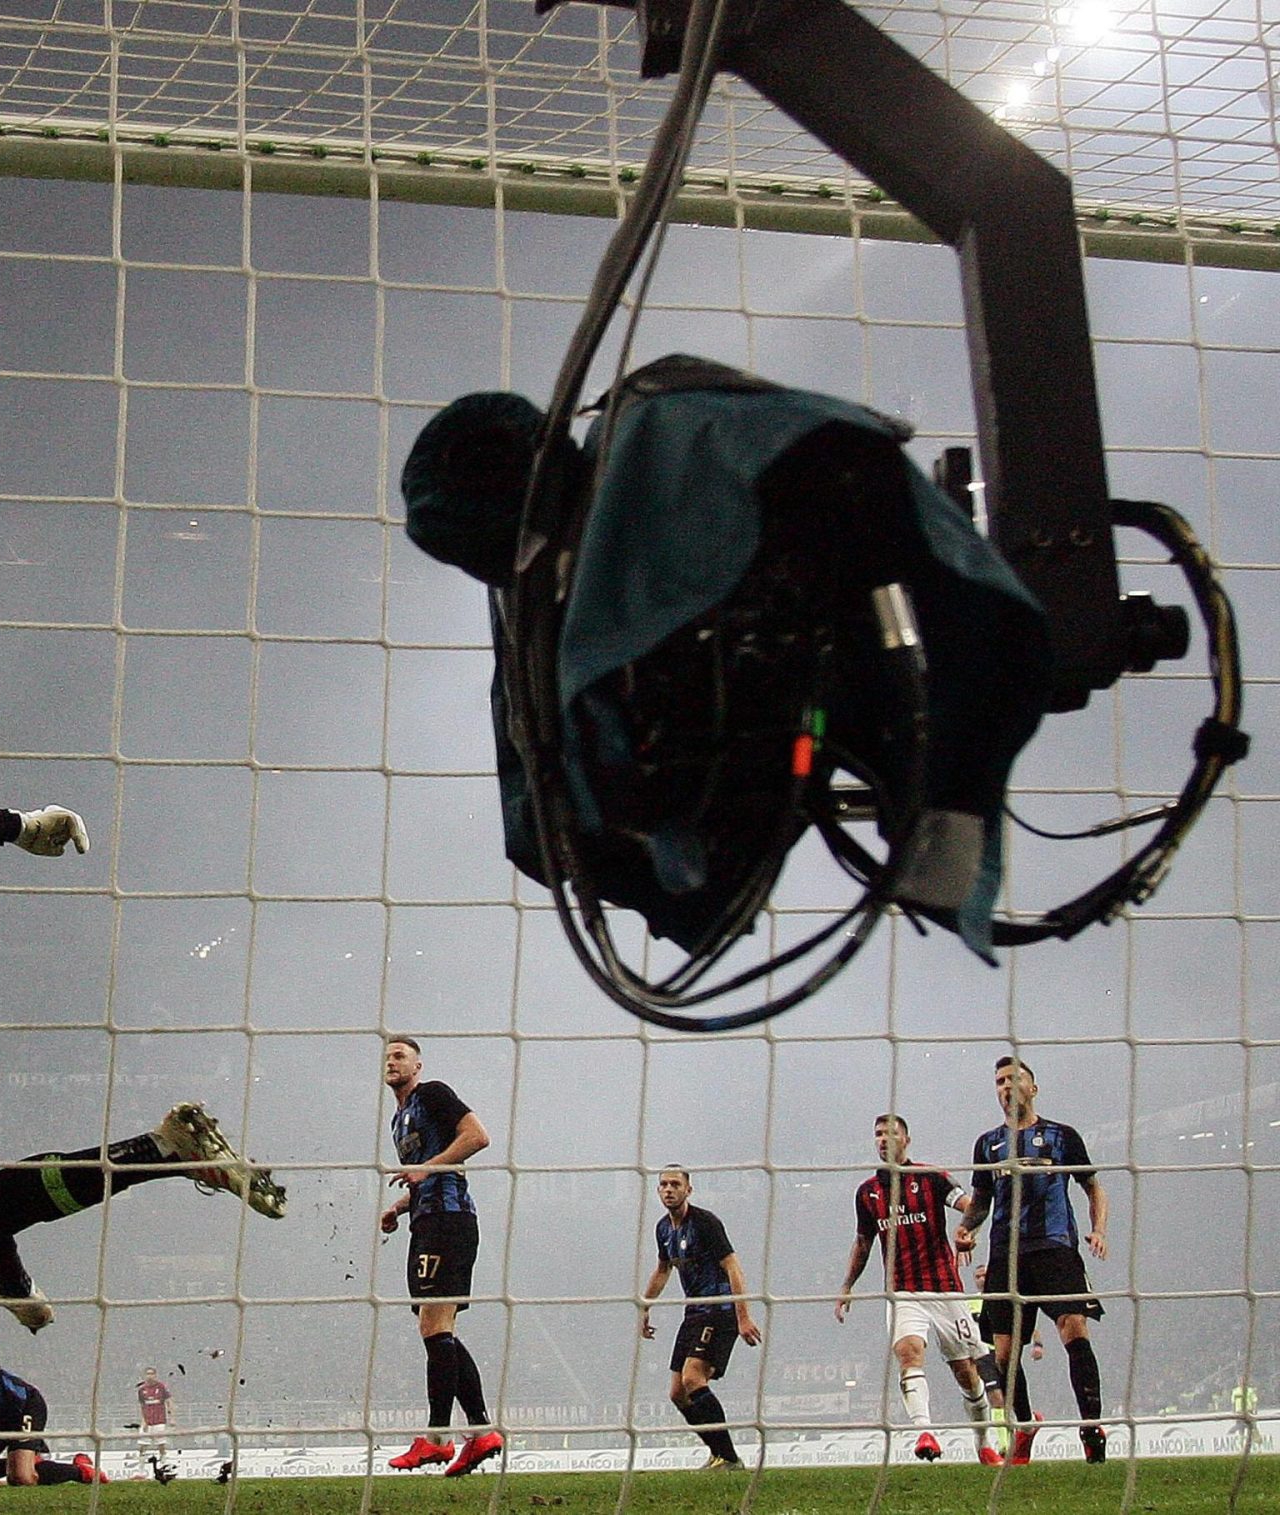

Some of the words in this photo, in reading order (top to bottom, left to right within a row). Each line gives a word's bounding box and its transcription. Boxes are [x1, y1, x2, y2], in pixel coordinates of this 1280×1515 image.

[417, 1254, 441, 1279] 37
[700, 1326, 714, 1344] 6
[955, 1318, 972, 1340] 13
[21, 1414, 32, 1433] 5
[1035, 1445, 1065, 1458] BANCO
[1149, 1439, 1184, 1454] BANCO
[265, 1466, 307, 1476] BANCO
[538, 1459, 561, 1469] BPM
[572, 1459, 612, 1469] BANCO
